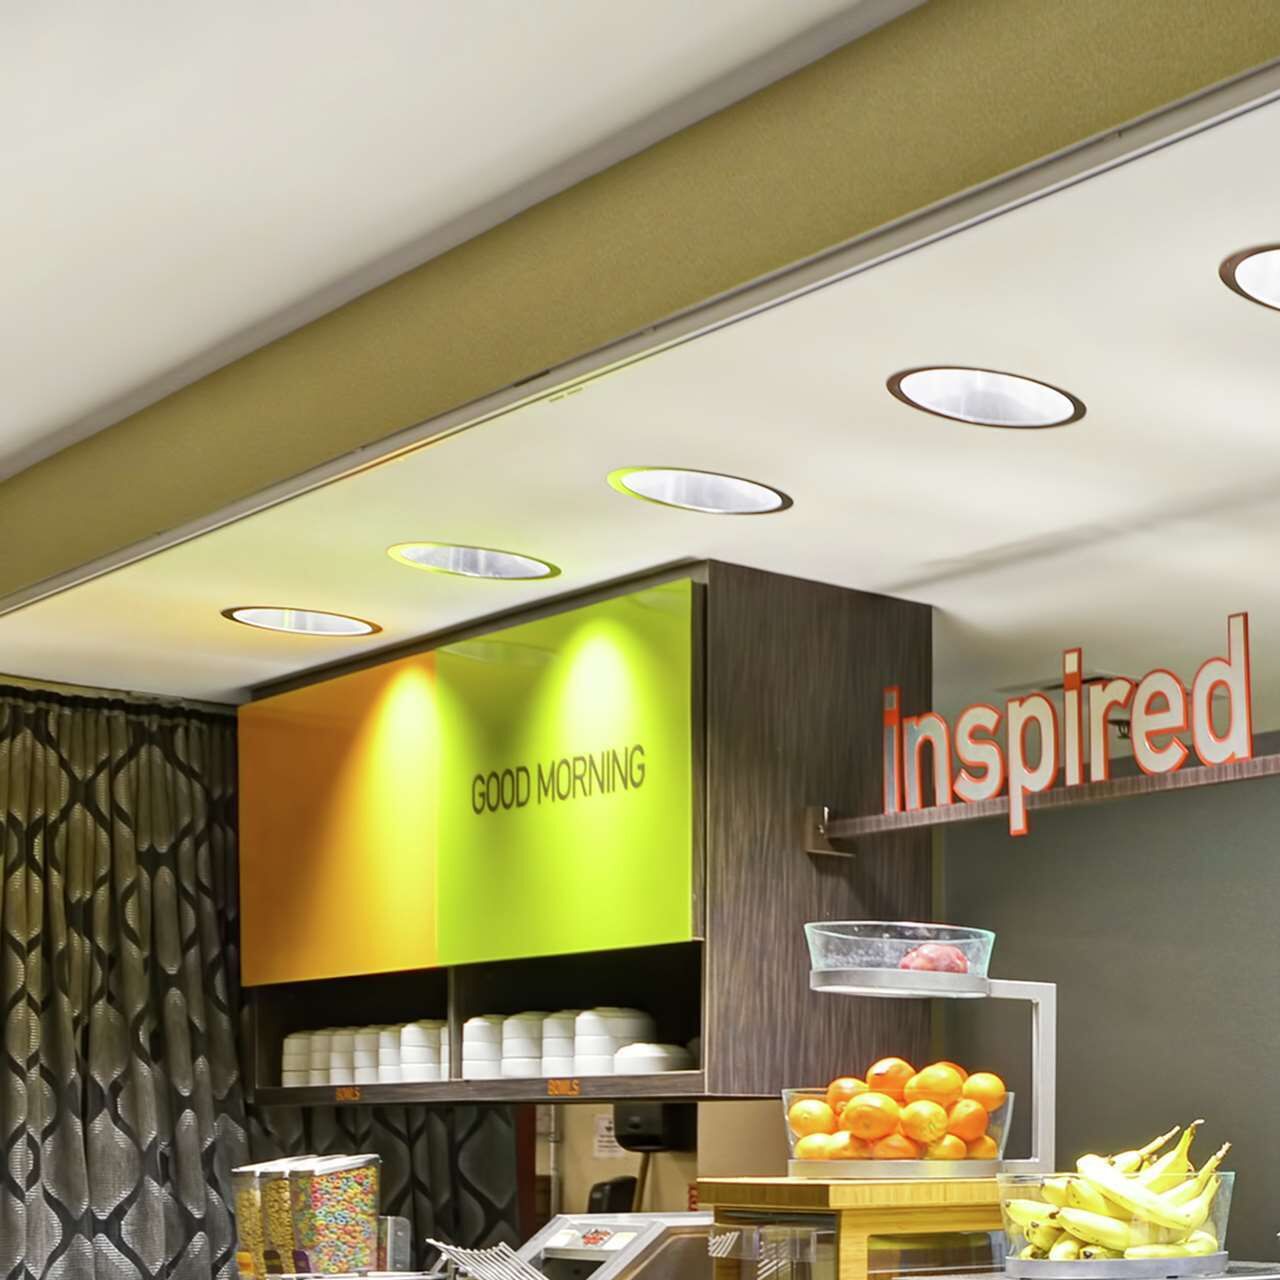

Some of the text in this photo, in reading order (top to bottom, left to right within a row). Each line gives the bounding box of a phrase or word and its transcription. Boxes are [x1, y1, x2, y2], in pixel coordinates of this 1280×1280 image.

[472, 744, 646, 815] GOOD MORNING
[883, 611, 1254, 837] inspired
